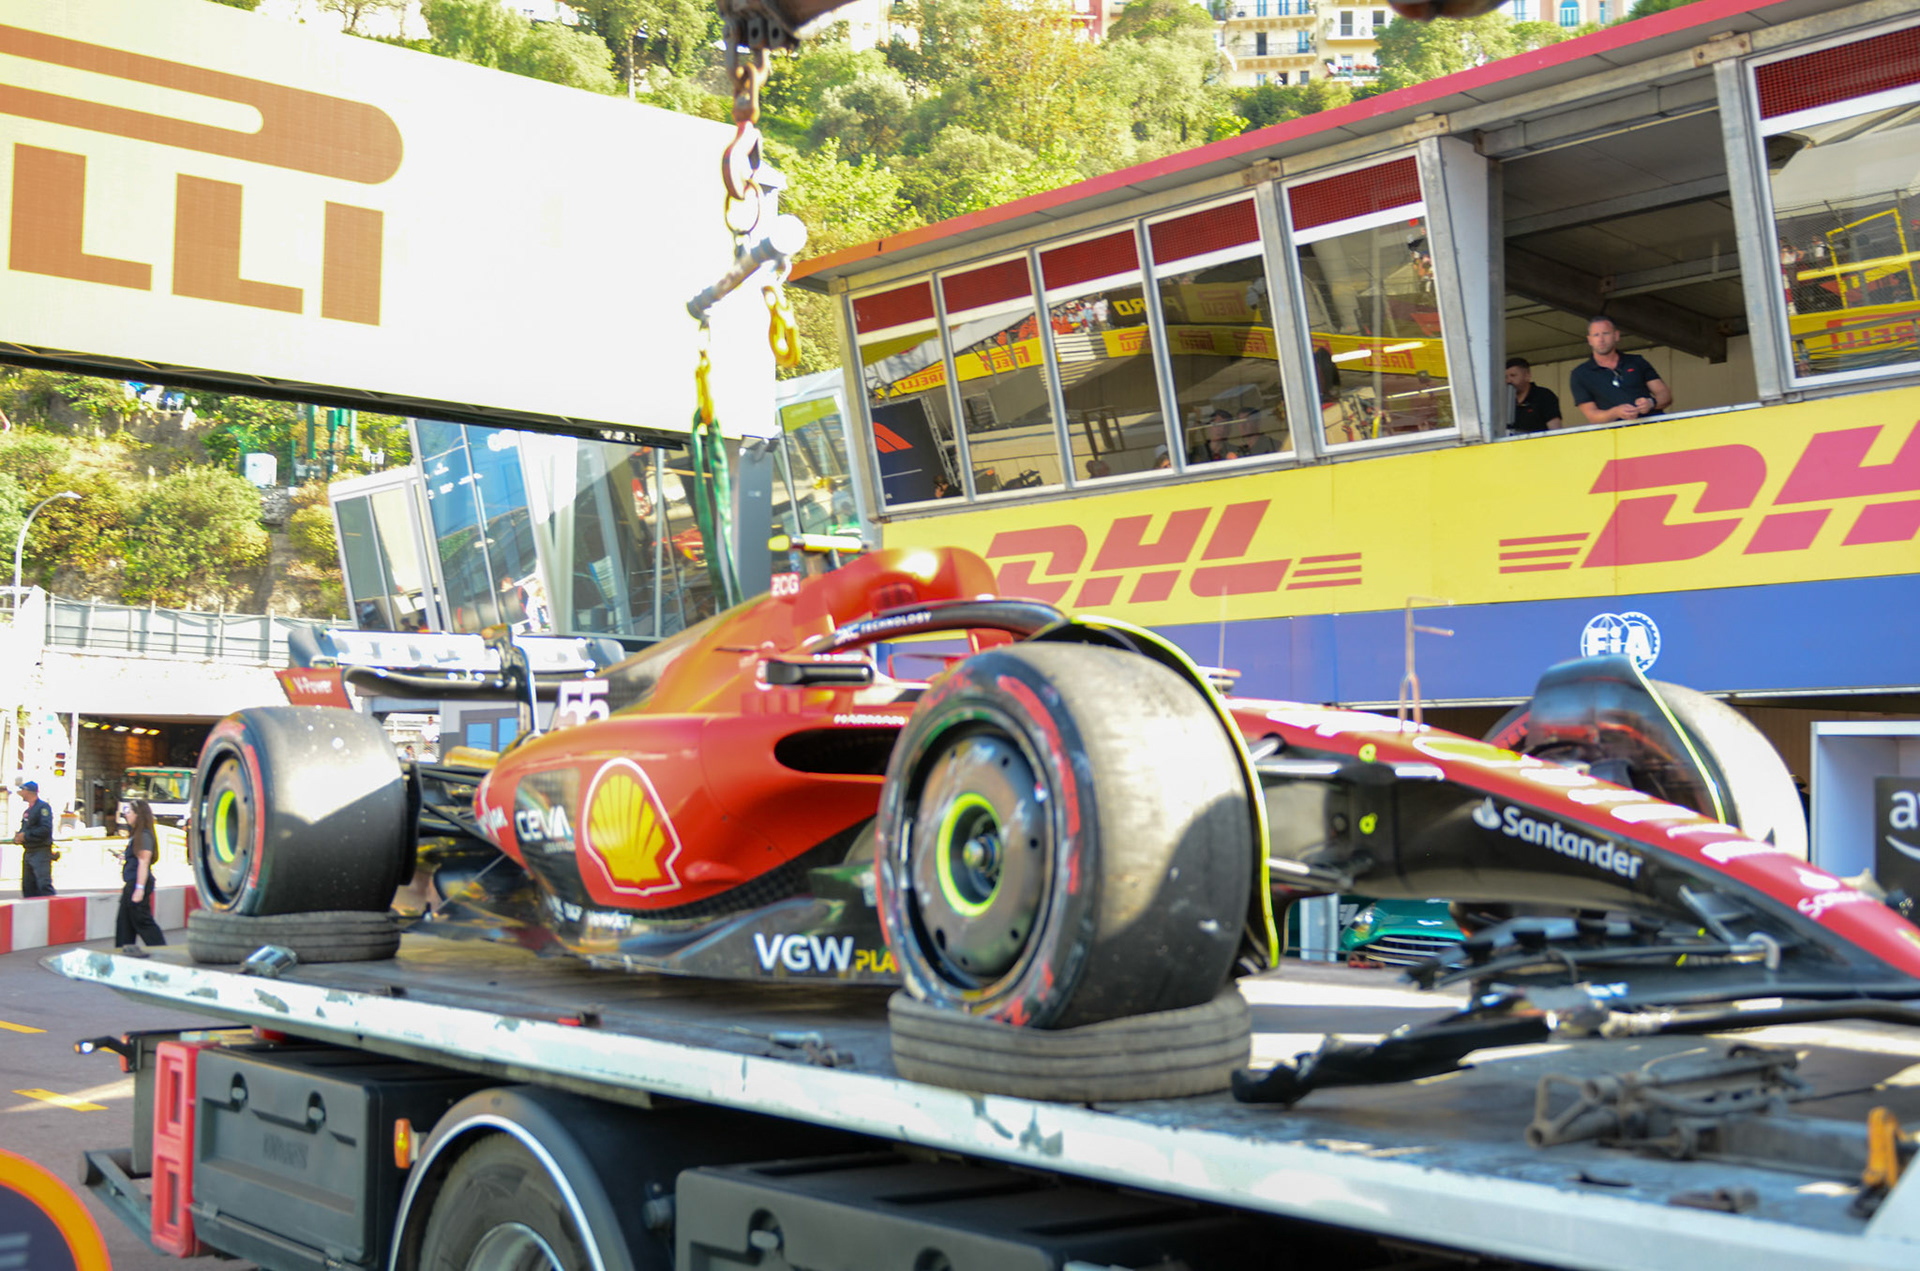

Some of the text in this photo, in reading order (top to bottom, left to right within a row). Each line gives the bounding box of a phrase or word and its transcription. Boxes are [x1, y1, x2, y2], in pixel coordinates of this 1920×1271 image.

[985, 499, 1293, 608] DHL
[861, 610, 932, 634] TECHNOLOGY
[559, 679, 610, 725] 55
[1501, 805, 1644, 880] Santander
[753, 933, 855, 972] VGW
